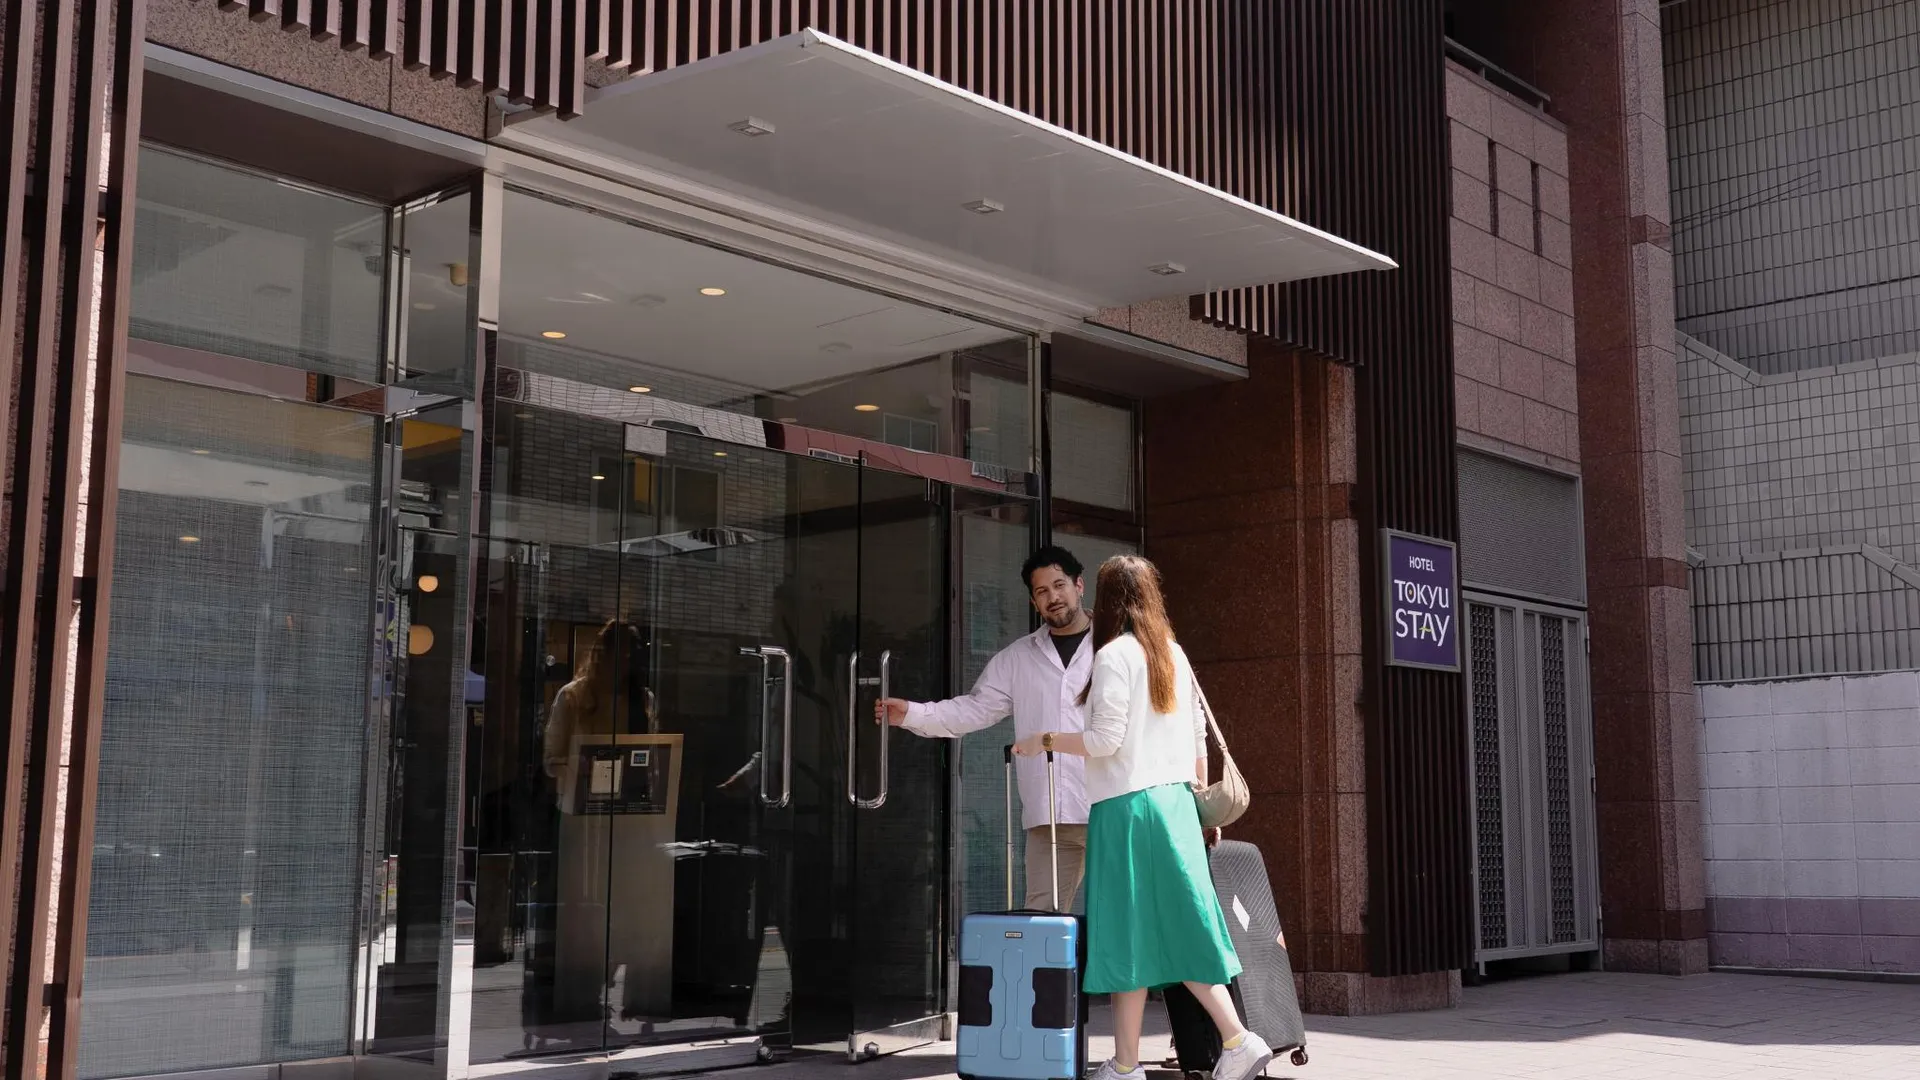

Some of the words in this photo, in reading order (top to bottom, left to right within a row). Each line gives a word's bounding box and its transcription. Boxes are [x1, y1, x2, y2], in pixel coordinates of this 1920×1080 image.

[1409, 555, 1435, 572] HOTEL
[1394, 579, 1450, 609] TOKYU
[1395, 607, 1451, 647] STAY
